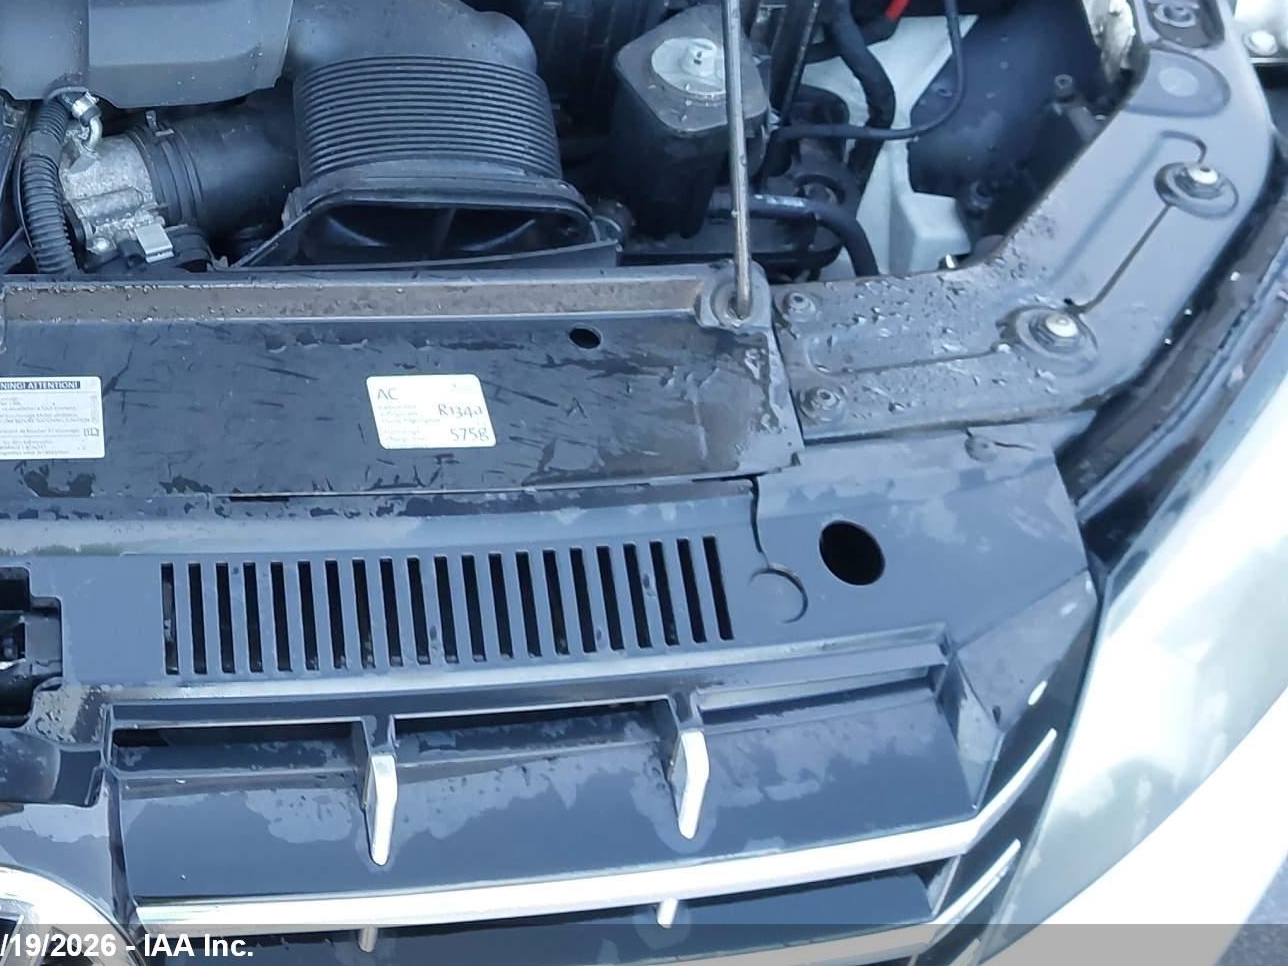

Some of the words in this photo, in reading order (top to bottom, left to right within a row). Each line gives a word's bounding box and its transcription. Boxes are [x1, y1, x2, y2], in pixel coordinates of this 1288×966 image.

[28, 380, 78, 390] ATTENTION!
[377, 388, 398, 401] AC
[438, 404, 483, 418] R134a
